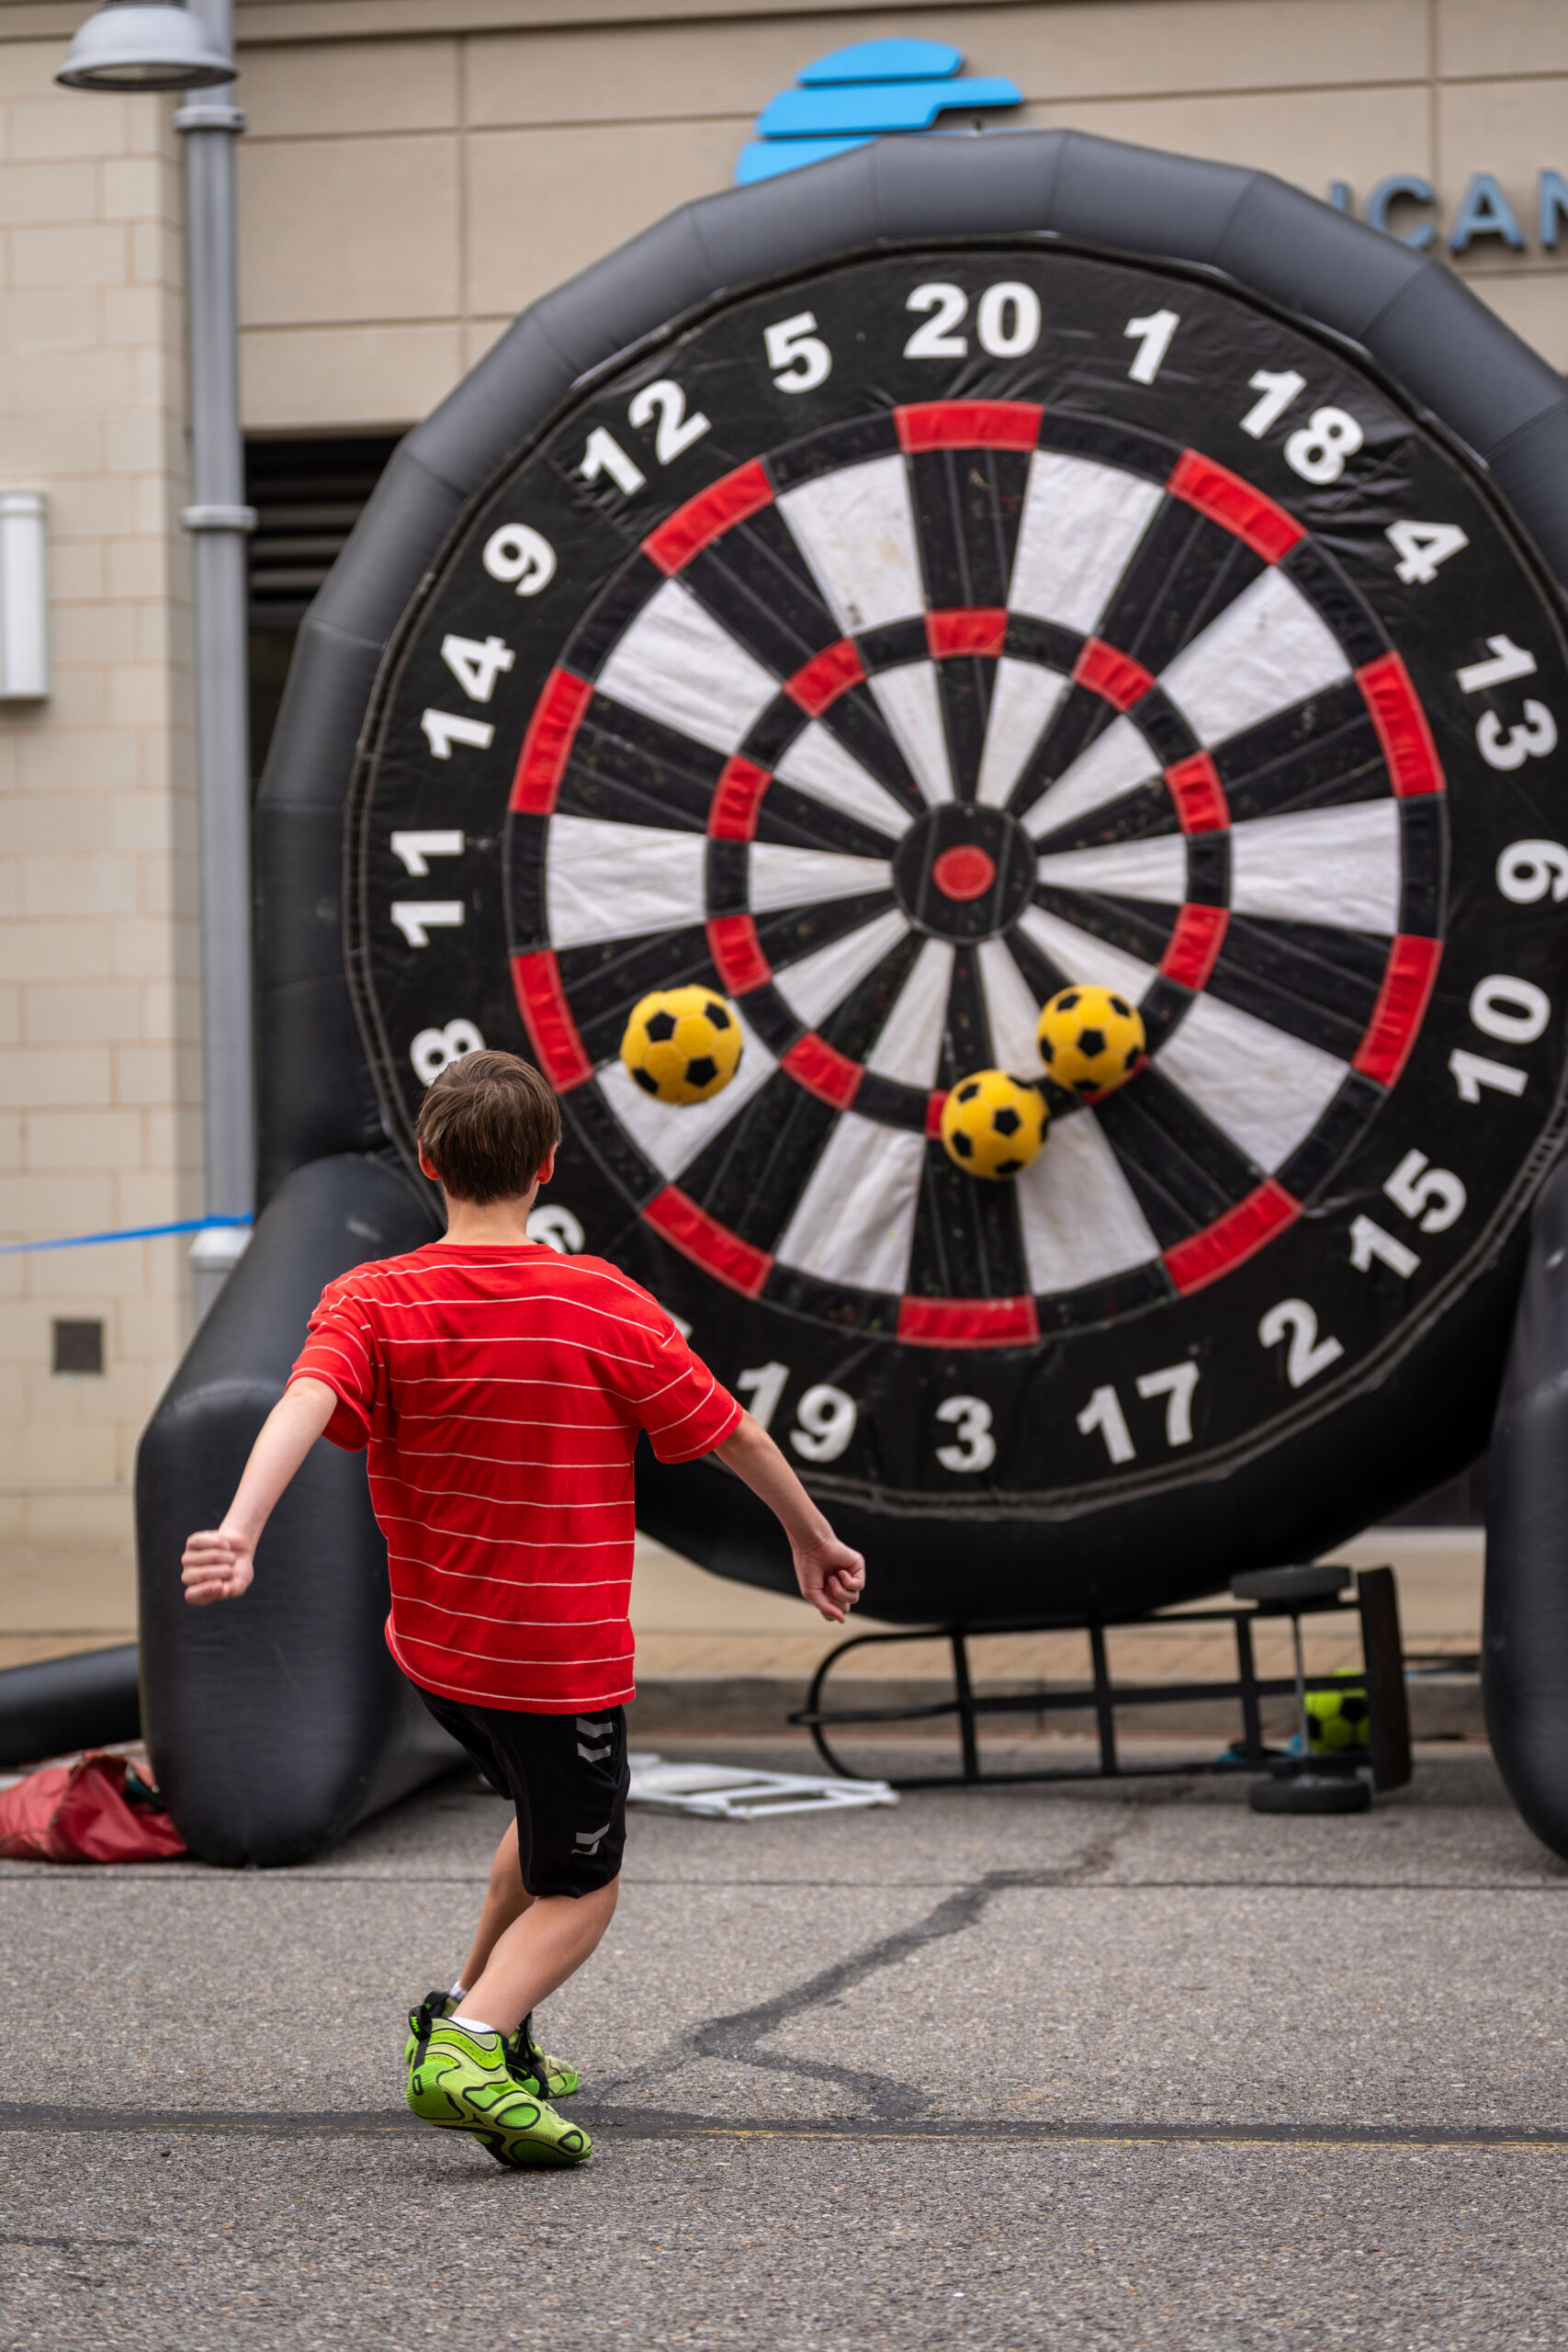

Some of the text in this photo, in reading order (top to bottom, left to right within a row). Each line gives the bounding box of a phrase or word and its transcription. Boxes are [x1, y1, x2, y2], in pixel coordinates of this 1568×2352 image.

[763, 311, 832, 394] 5
[902, 281, 1042, 359] 20
[1123, 309, 1180, 384] 1
[578, 379, 711, 495] 12
[1239, 369, 1365, 484] 18
[482, 523, 556, 596] 9
[1385, 520, 1469, 583] 4
[420, 634, 515, 759] 14
[1456, 634, 1558, 770] 13
[390, 830, 465, 947] 11
[1449, 974, 1551, 1102] 10
[1350, 1150, 1466, 1277] 15
[1259, 1299, 1343, 1387] 2
[738, 1363, 857, 1462] 19
[936, 1396, 995, 1471] 3
[1077, 1363, 1199, 1464] 17
